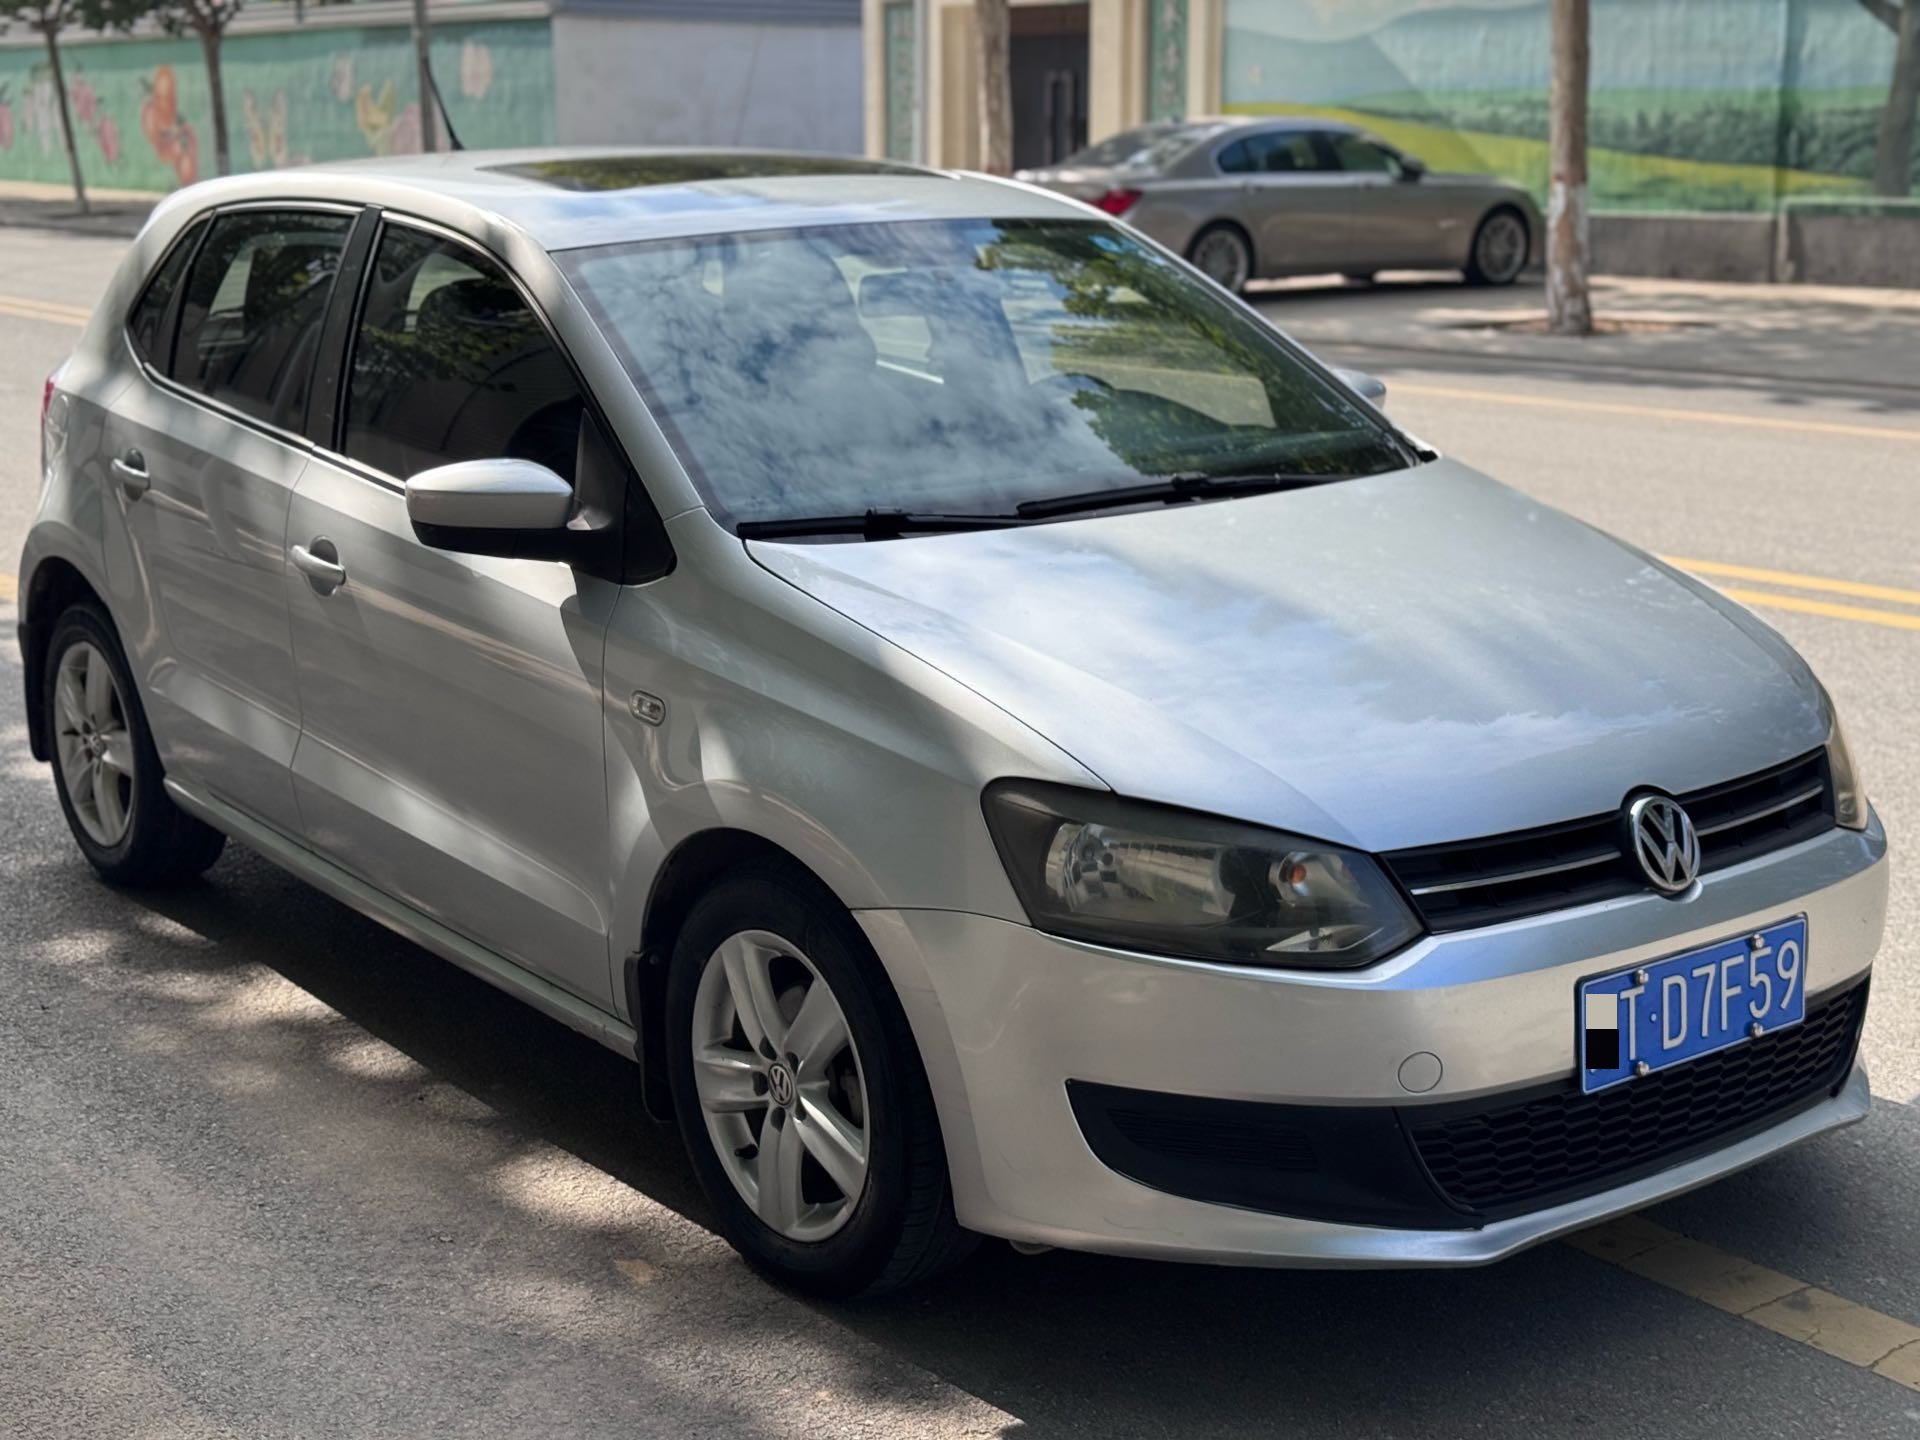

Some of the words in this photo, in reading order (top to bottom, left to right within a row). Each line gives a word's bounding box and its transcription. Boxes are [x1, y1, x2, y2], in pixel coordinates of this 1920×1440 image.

[1634, 798, 1699, 889] VW
[1586, 940, 1800, 1071] T·D7F59
[770, 1065, 792, 1104] VW
